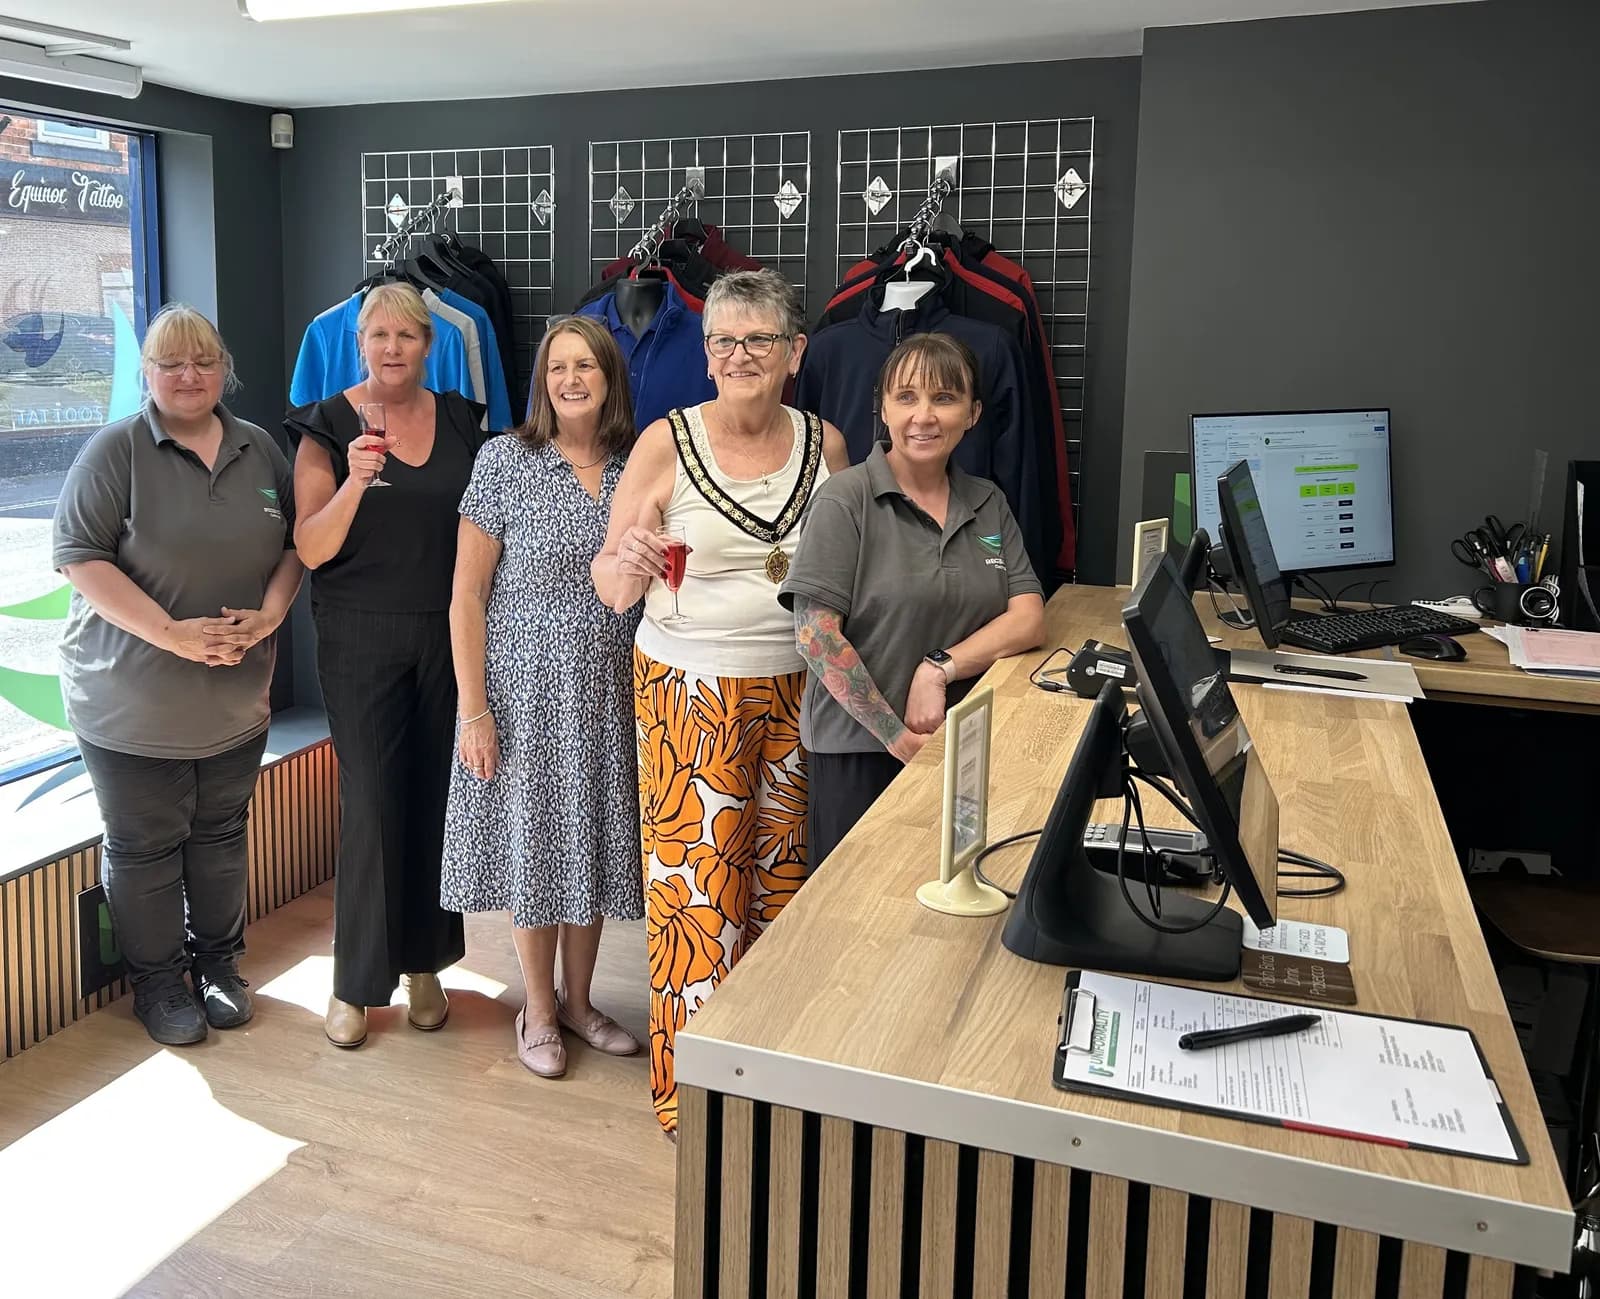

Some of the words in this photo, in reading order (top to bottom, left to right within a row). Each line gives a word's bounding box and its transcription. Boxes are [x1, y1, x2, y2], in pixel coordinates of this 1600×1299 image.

[71, 171, 123, 213] Tattoo
[1284, 967, 1301, 986] Drink
[1310, 965, 1327, 996] Prosecco
